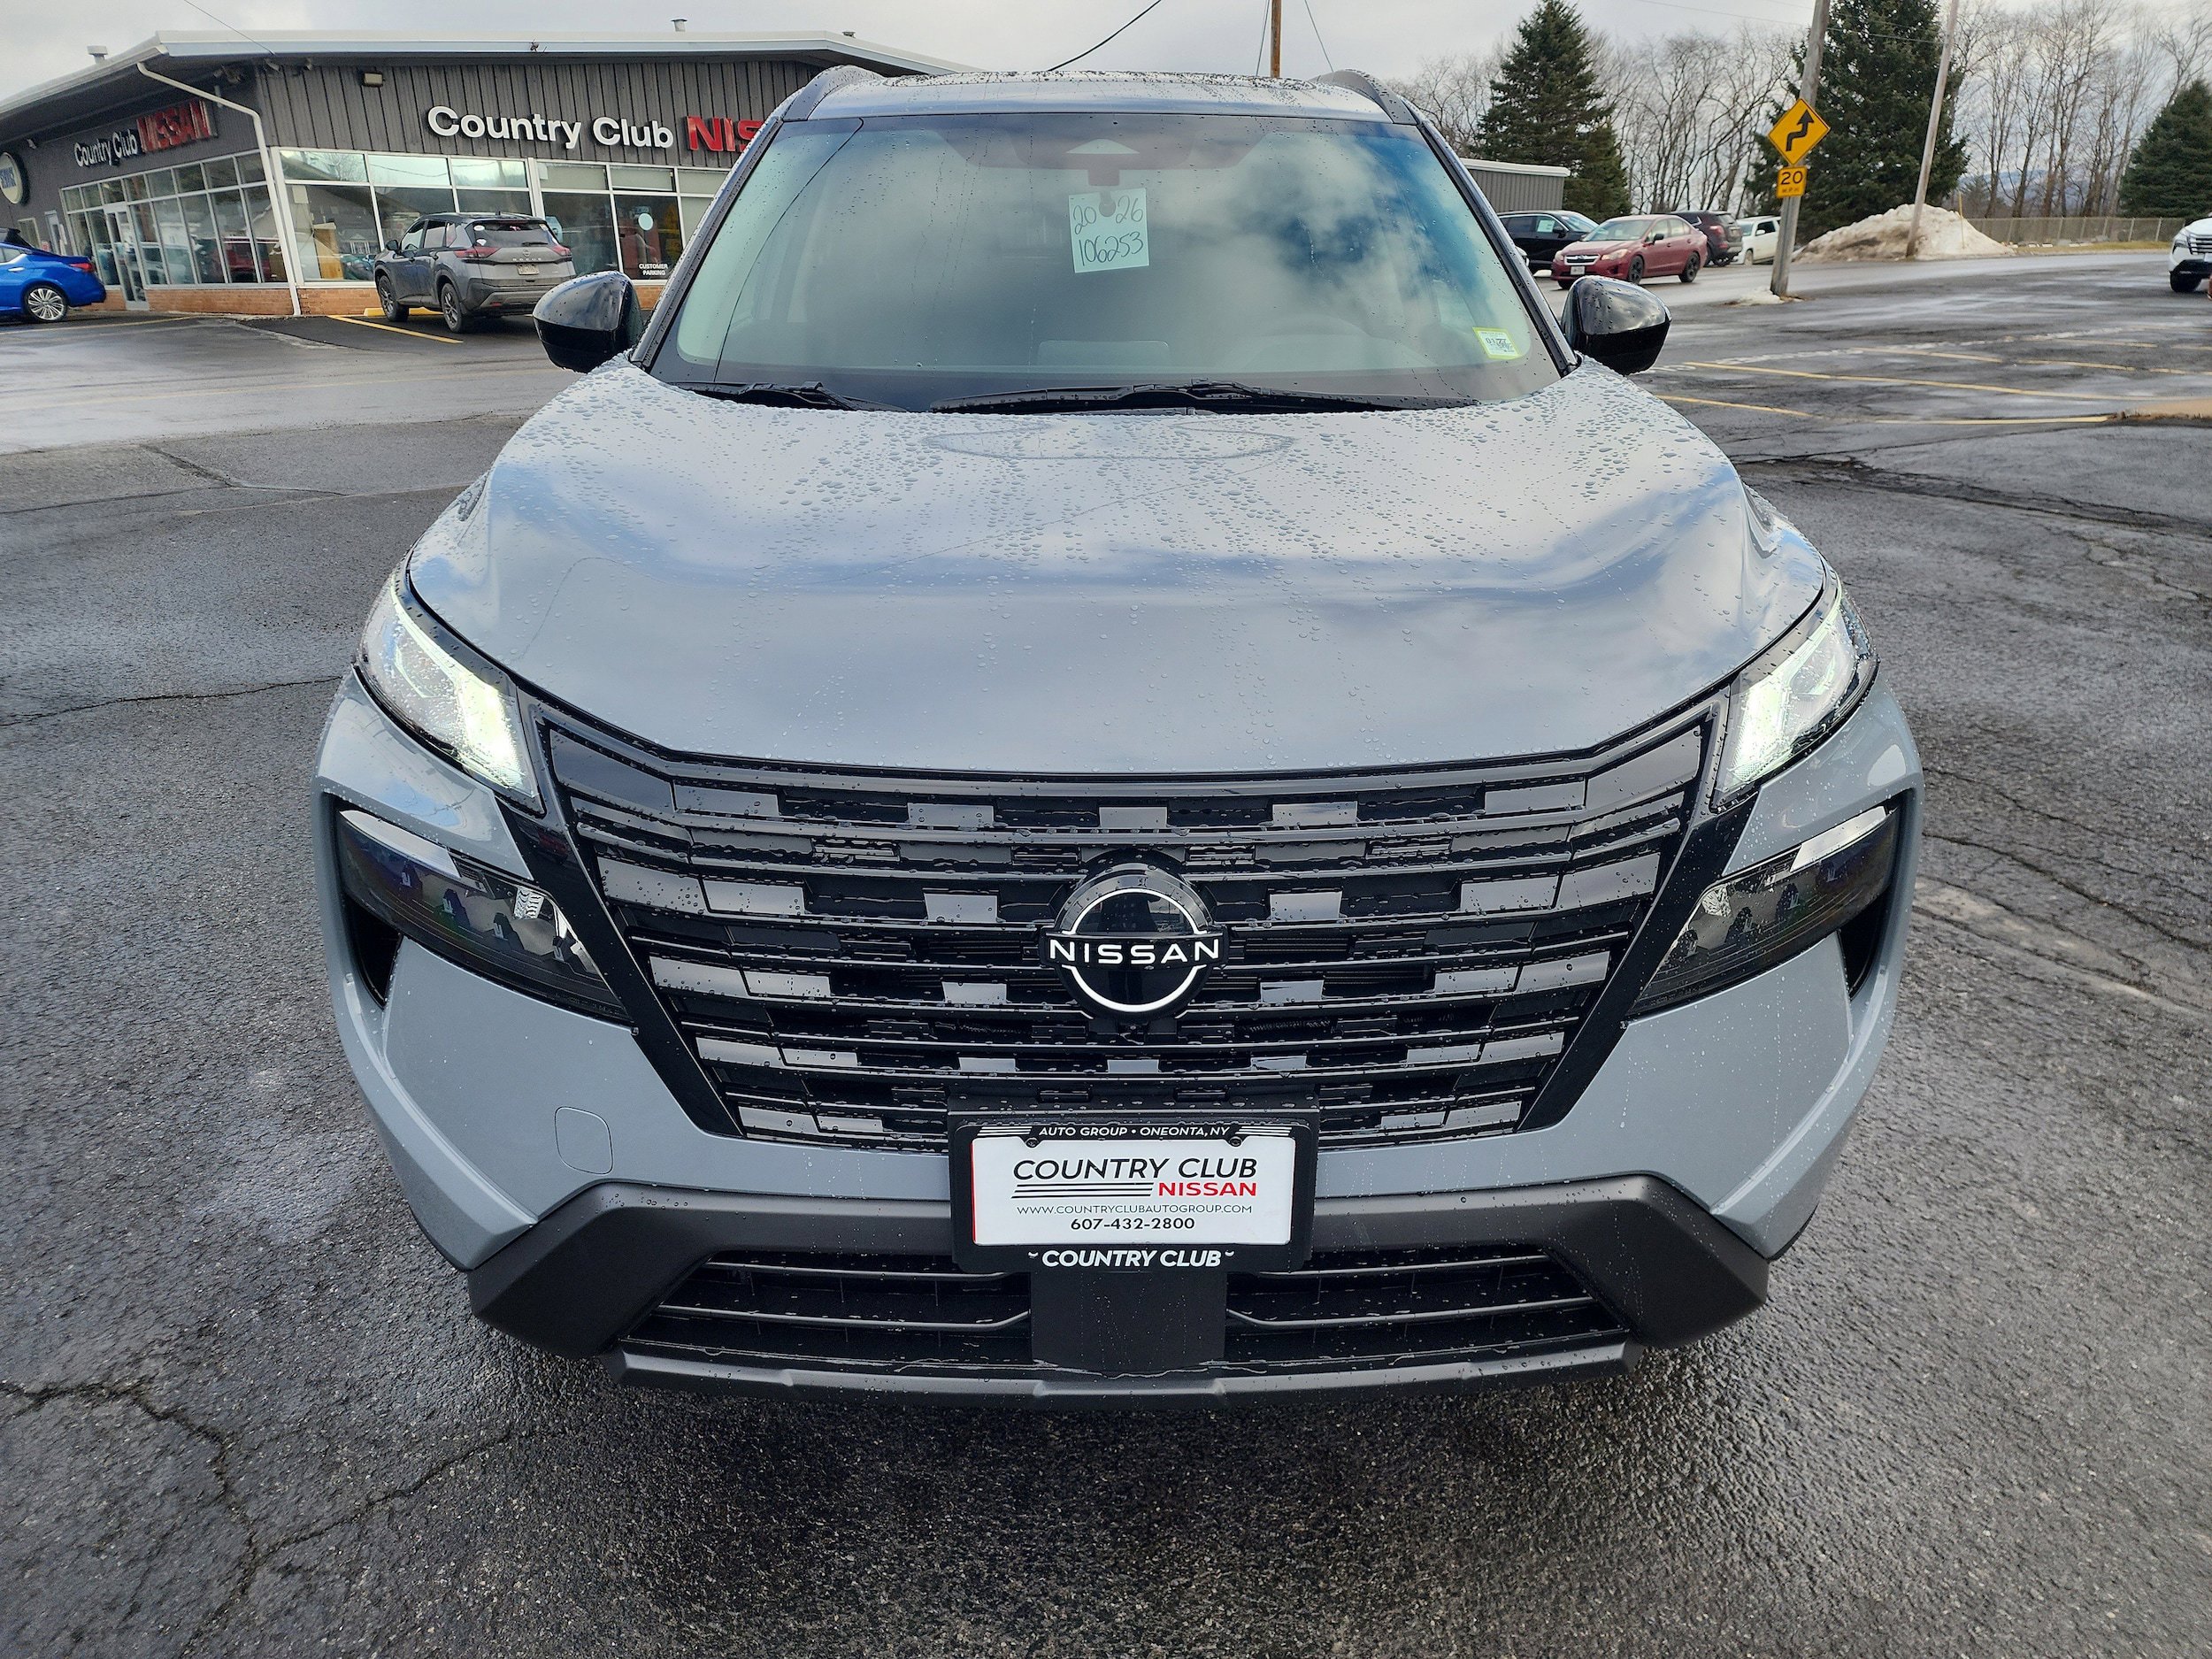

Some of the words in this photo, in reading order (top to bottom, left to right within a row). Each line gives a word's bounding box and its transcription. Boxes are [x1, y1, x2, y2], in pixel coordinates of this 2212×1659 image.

[427, 105, 582, 150] Country
[593, 116, 674, 149] Club
[74, 138, 112, 166] Country
[112, 128, 138, 158] Club
[1780, 171, 1803, 185] 20
[1072, 204, 1097, 235] 20
[1115, 195, 1144, 224] 26
[1079, 230, 1144, 266] 106253
[1049, 938, 1219, 964] NISSAN
[1039, 1126, 1076, 1136] AUTO
[1079, 1126, 1128, 1136] GROUP
[1013, 1157, 1170, 1179] COUNTRY
[1178, 1157, 1257, 1179] CLUB
[1158, 1182, 1257, 1196] NISSAN
[1017, 1204, 1252, 1215] WWW.COUNTRYCLUBAUTOGROUP.COM
[1071, 1217, 1195, 1230] 607-432-2800
[1042, 1249, 1158, 1267] COUNTRY
[1159, 1249, 1222, 1267] CLUB
